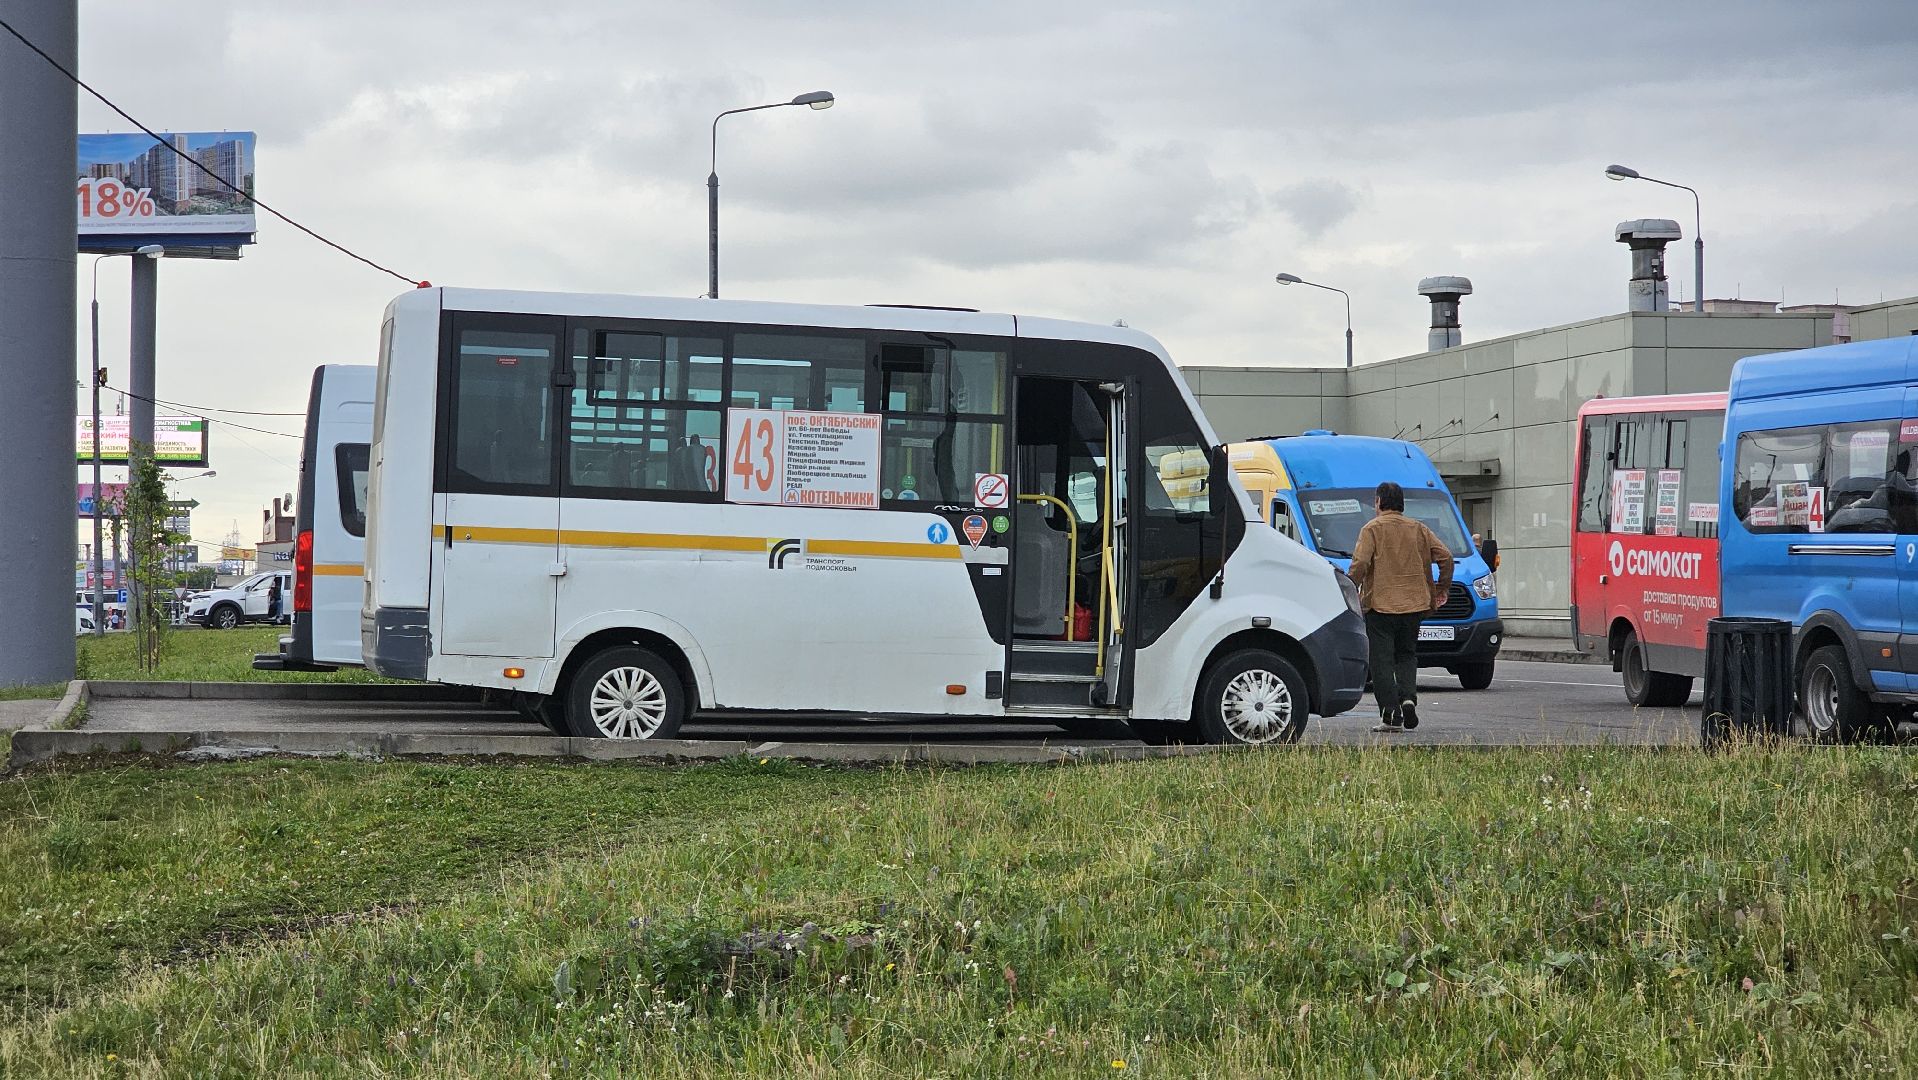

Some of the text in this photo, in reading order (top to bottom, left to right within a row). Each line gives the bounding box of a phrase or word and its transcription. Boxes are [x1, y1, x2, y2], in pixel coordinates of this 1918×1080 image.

[78, 182, 153, 218] 18%
[810, 416, 878, 429] ОКТЯБРЬСКИЙ
[734, 418, 774, 492] 43
[787, 457, 838, 465] Птицефабрика
[801, 490, 874, 505] КОТЕЛЬНИКИ
[1810, 491, 1823, 528] 4
[1627, 549, 1702, 580] самокат
[1643, 590, 1717, 611] доставка продуктов
[1644, 609, 1684, 629] от 15 минут
